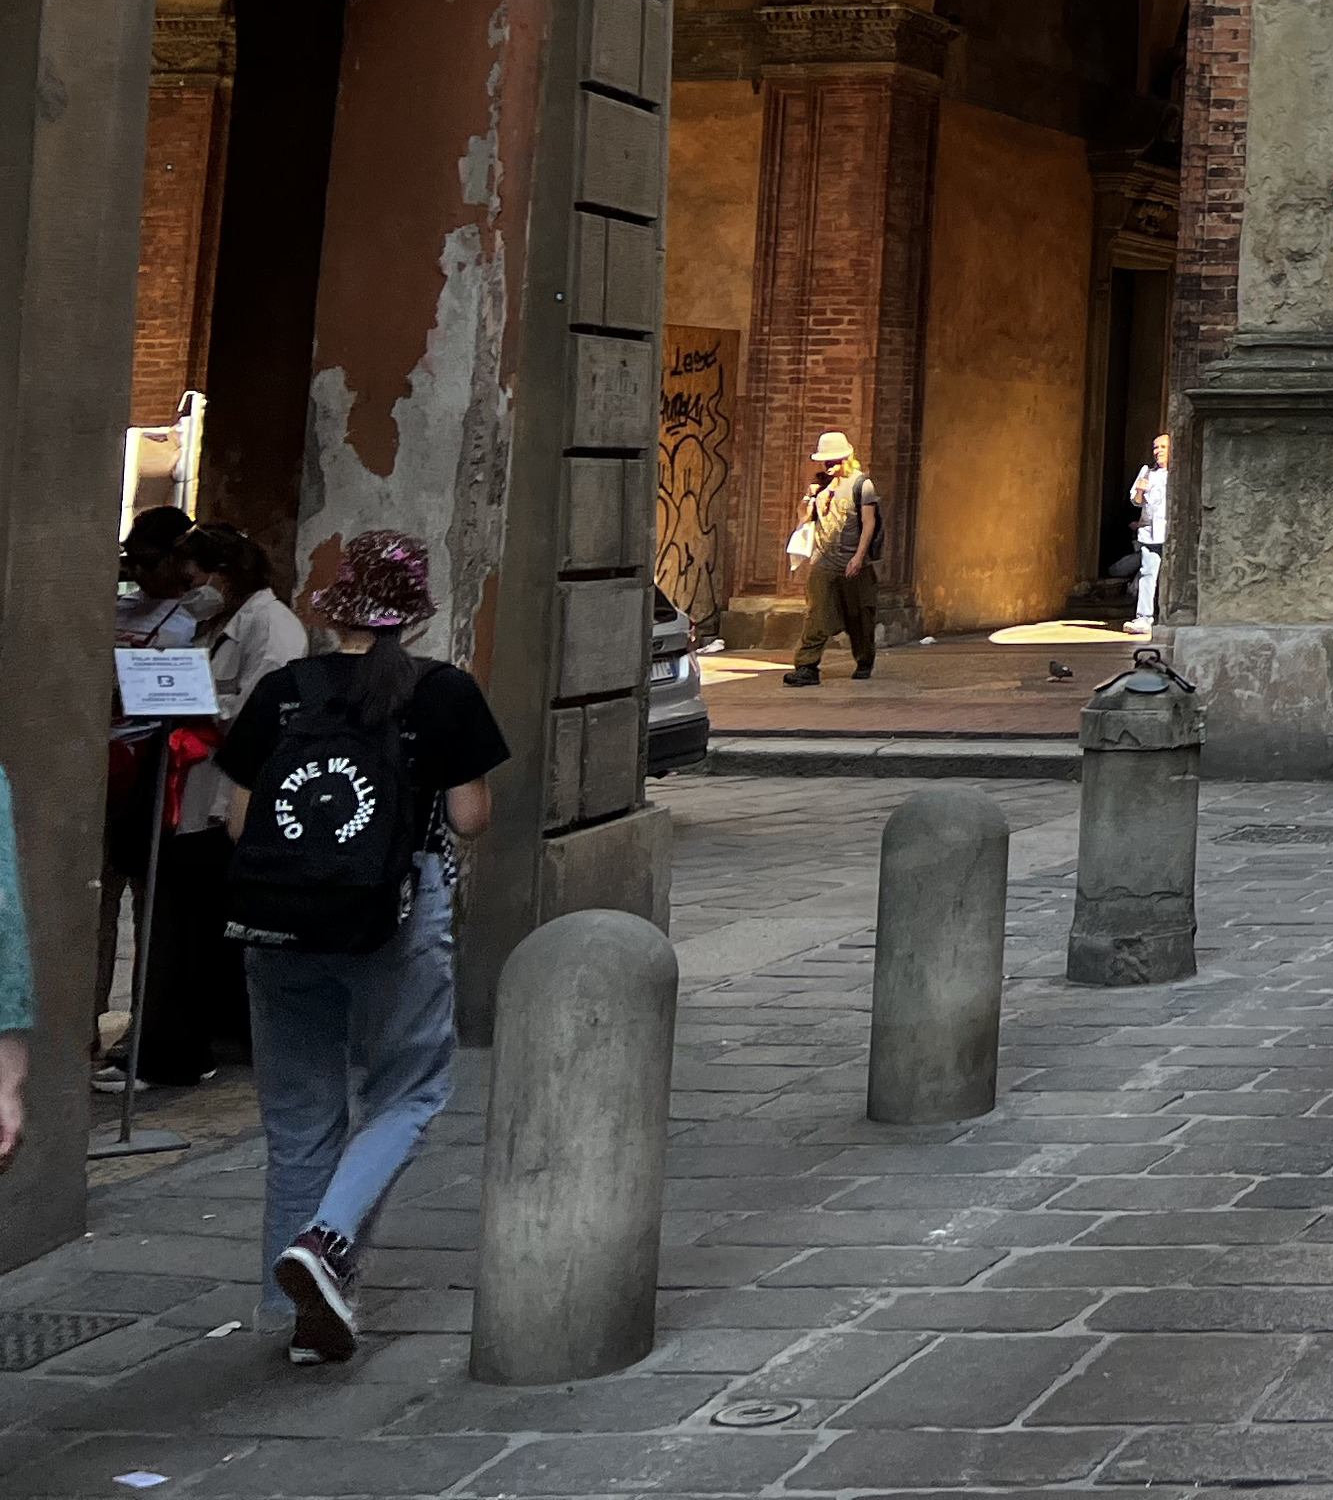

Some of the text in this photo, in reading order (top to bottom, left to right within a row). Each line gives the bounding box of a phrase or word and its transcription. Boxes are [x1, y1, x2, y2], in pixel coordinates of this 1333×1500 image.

[275, 756, 374, 840] OFF THE WALL
